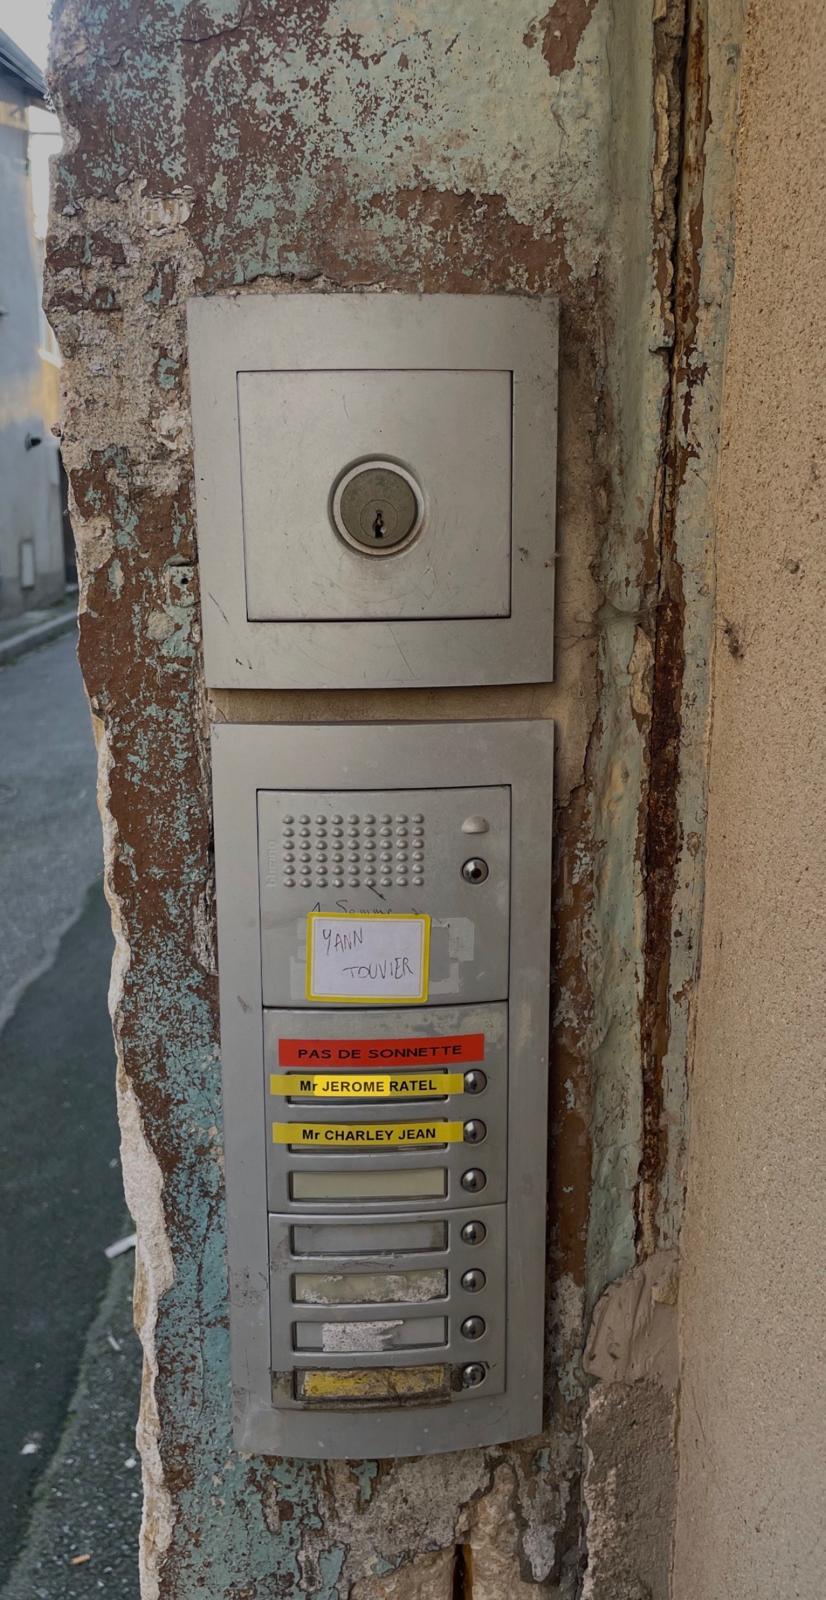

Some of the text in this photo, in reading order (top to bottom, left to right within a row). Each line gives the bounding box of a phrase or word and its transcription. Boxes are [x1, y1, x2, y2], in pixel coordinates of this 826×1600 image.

[322, 927, 363, 956] YANN
[343, 957, 413, 979] TOUVIER
[298, 1044, 462, 1059] PAS DE SONNETTE
[300, 1079, 437, 1092] Mr JEROME RATEL
[302, 1128, 436, 1141] Mr CHARLEY JEAN
